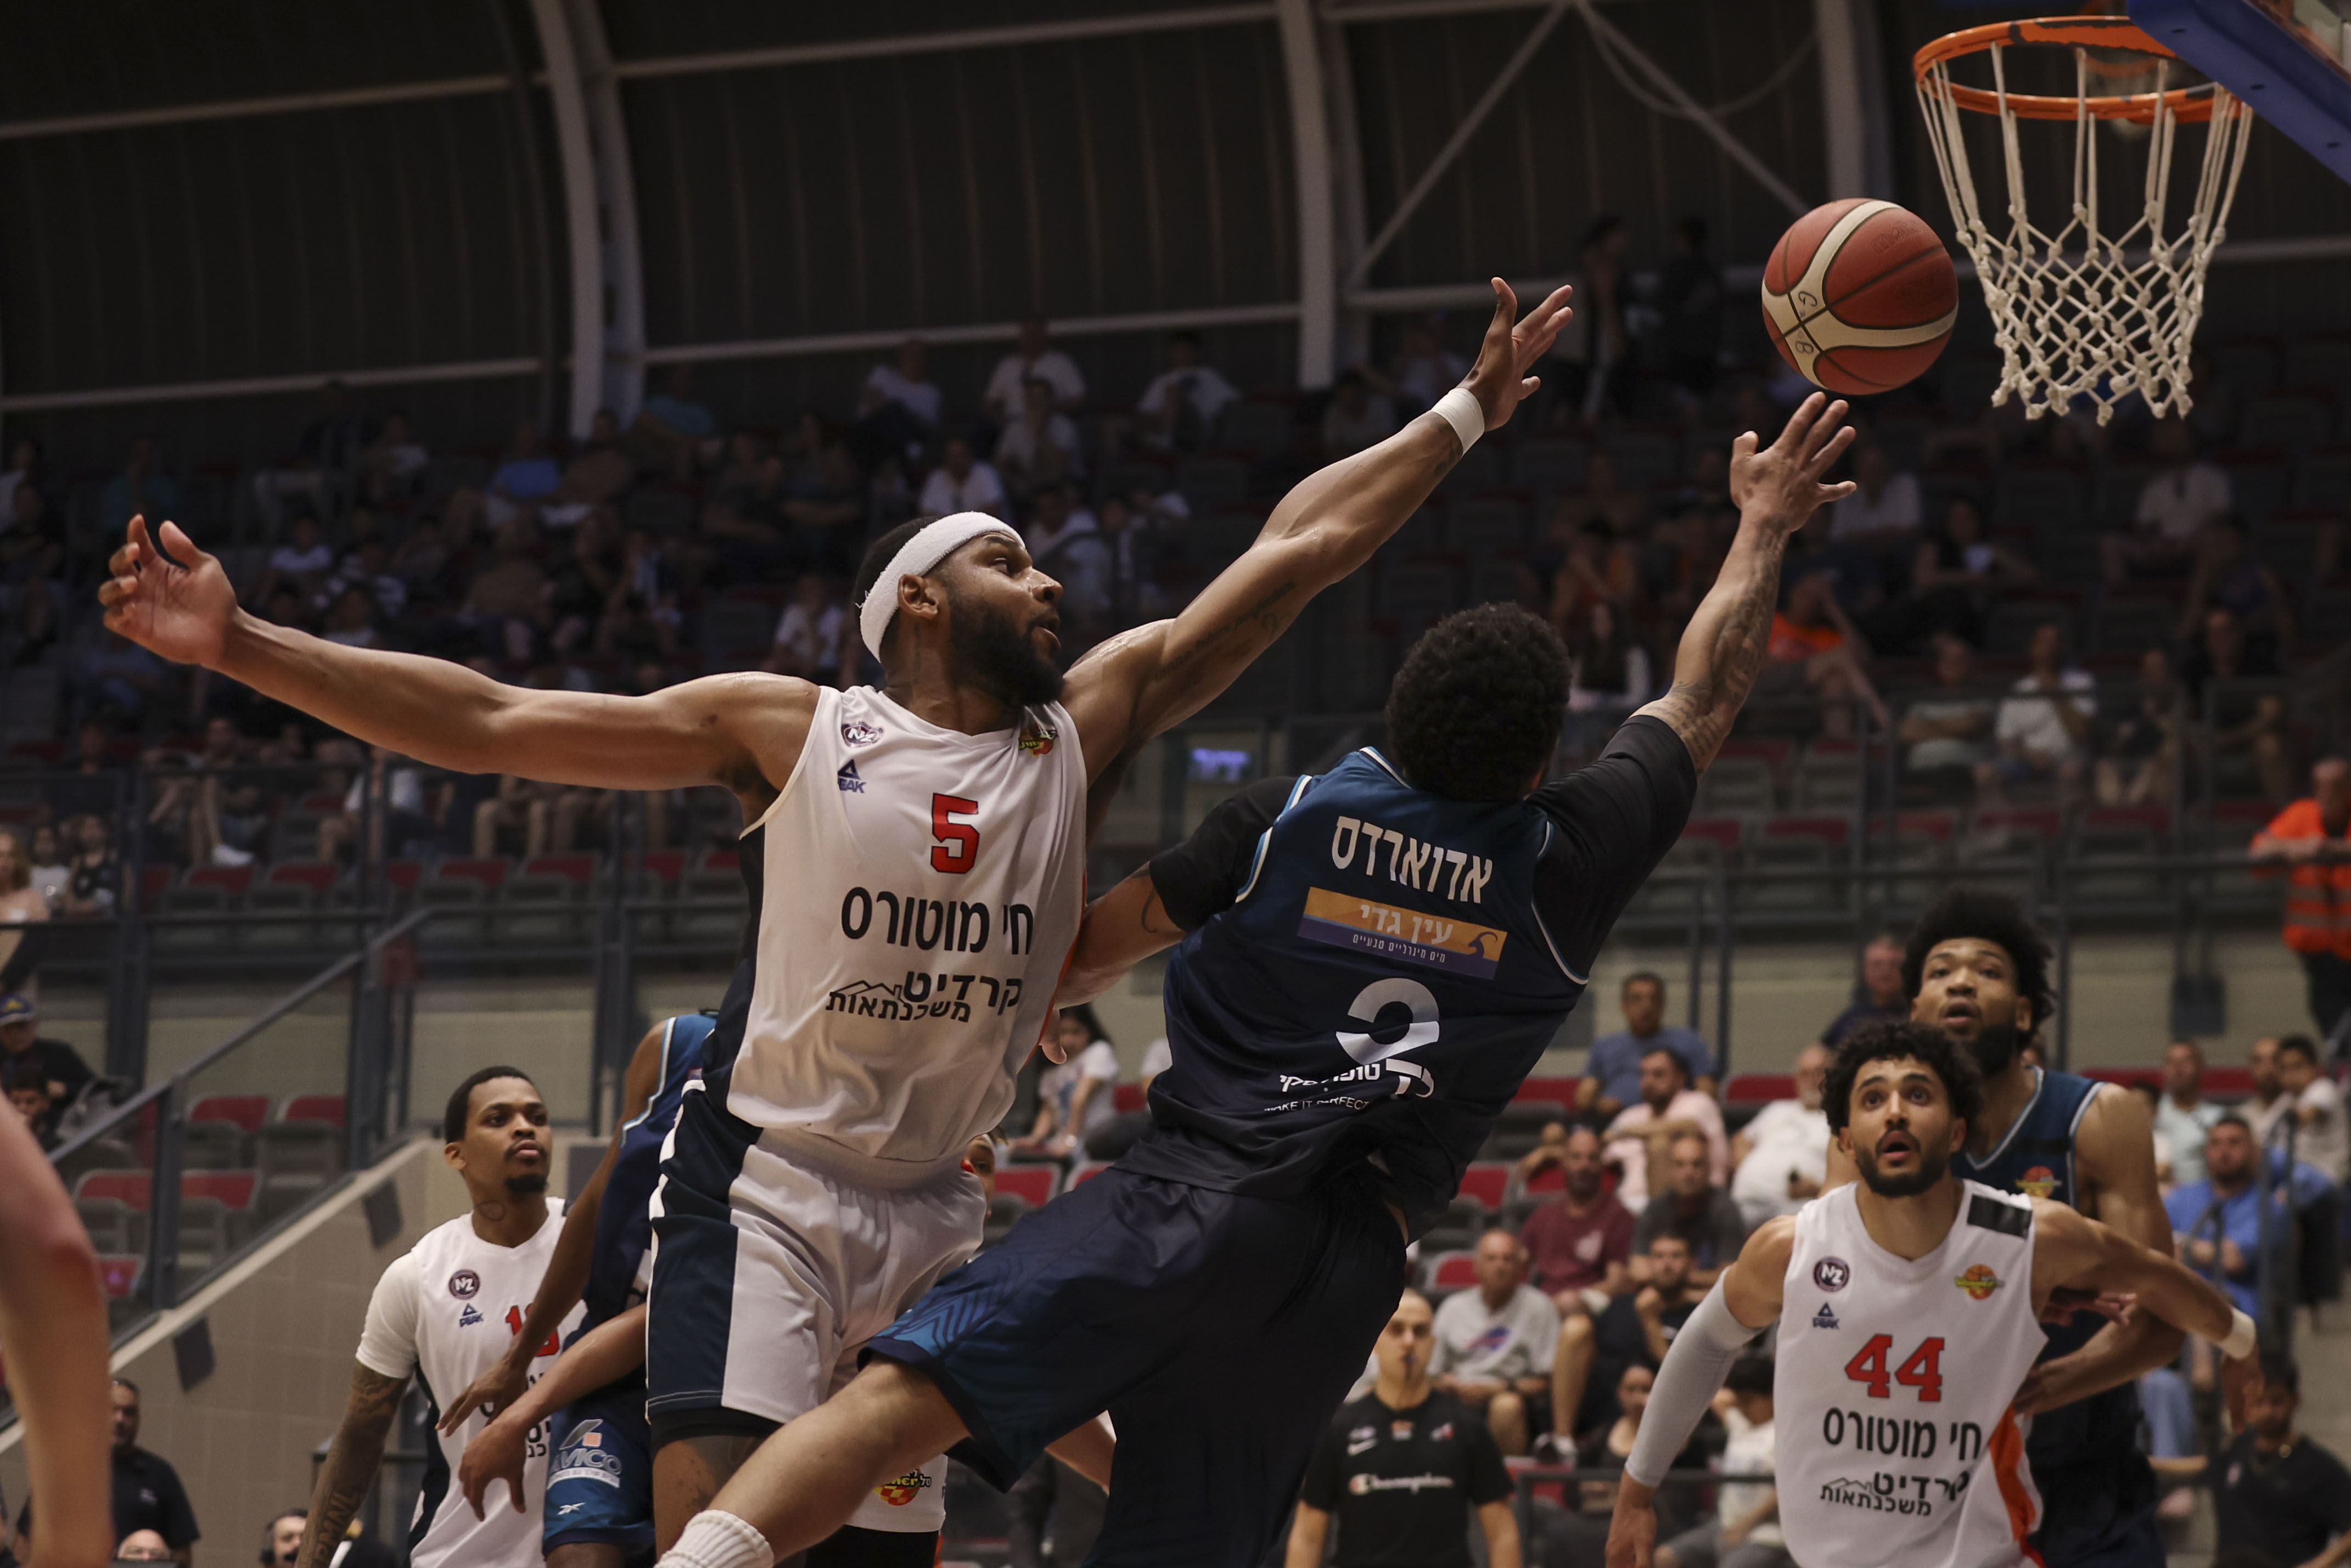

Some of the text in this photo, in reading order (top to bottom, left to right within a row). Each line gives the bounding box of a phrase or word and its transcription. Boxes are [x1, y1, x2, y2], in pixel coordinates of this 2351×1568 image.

[838, 777, 867, 794] EAK
[930, 793, 980, 874] 5
[1332, 816, 1493, 903] אדוארדס
[841, 886, 1034, 955] חי מוטורס
[1360, 904, 1454, 945] עין גדי
[826, 990, 971, 1023] משכנתאות
[902, 970, 1023, 1017] קרדיט
[1336, 977, 1440, 1065] 2
[1844, 1333, 1945, 1402] 44
[1823, 1407, 1982, 1461] חי מוטורס
[1820, 1485, 1932, 1516] משכנתאות
